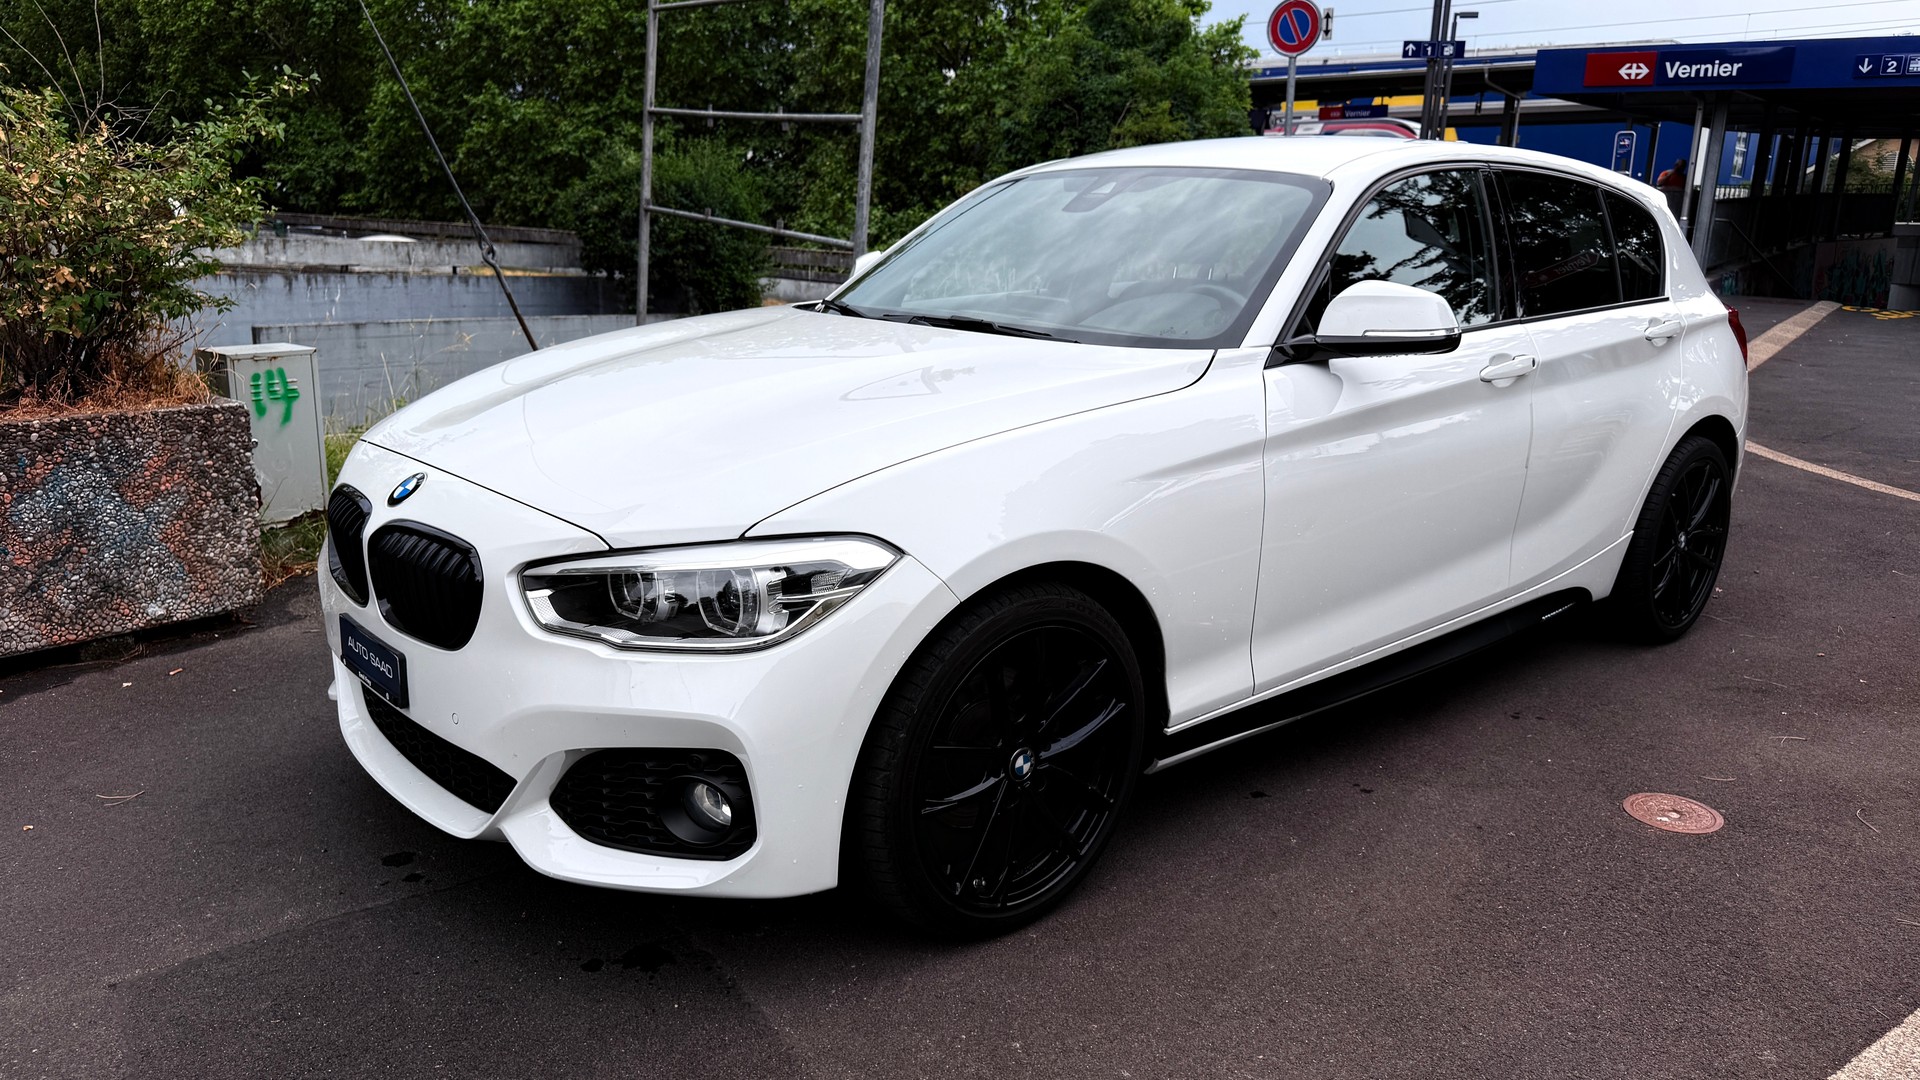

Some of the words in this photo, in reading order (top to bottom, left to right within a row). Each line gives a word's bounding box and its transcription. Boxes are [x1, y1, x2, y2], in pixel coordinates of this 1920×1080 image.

[1425, 46, 1432, 56] 1
[1665, 60, 1743, 79] Vernier
[1886, 60, 1898, 73] 2
[1344, 109, 1371, 117] Vernier
[348, 636, 368, 660] AUTO
[369, 652, 393, 679] SAAD
